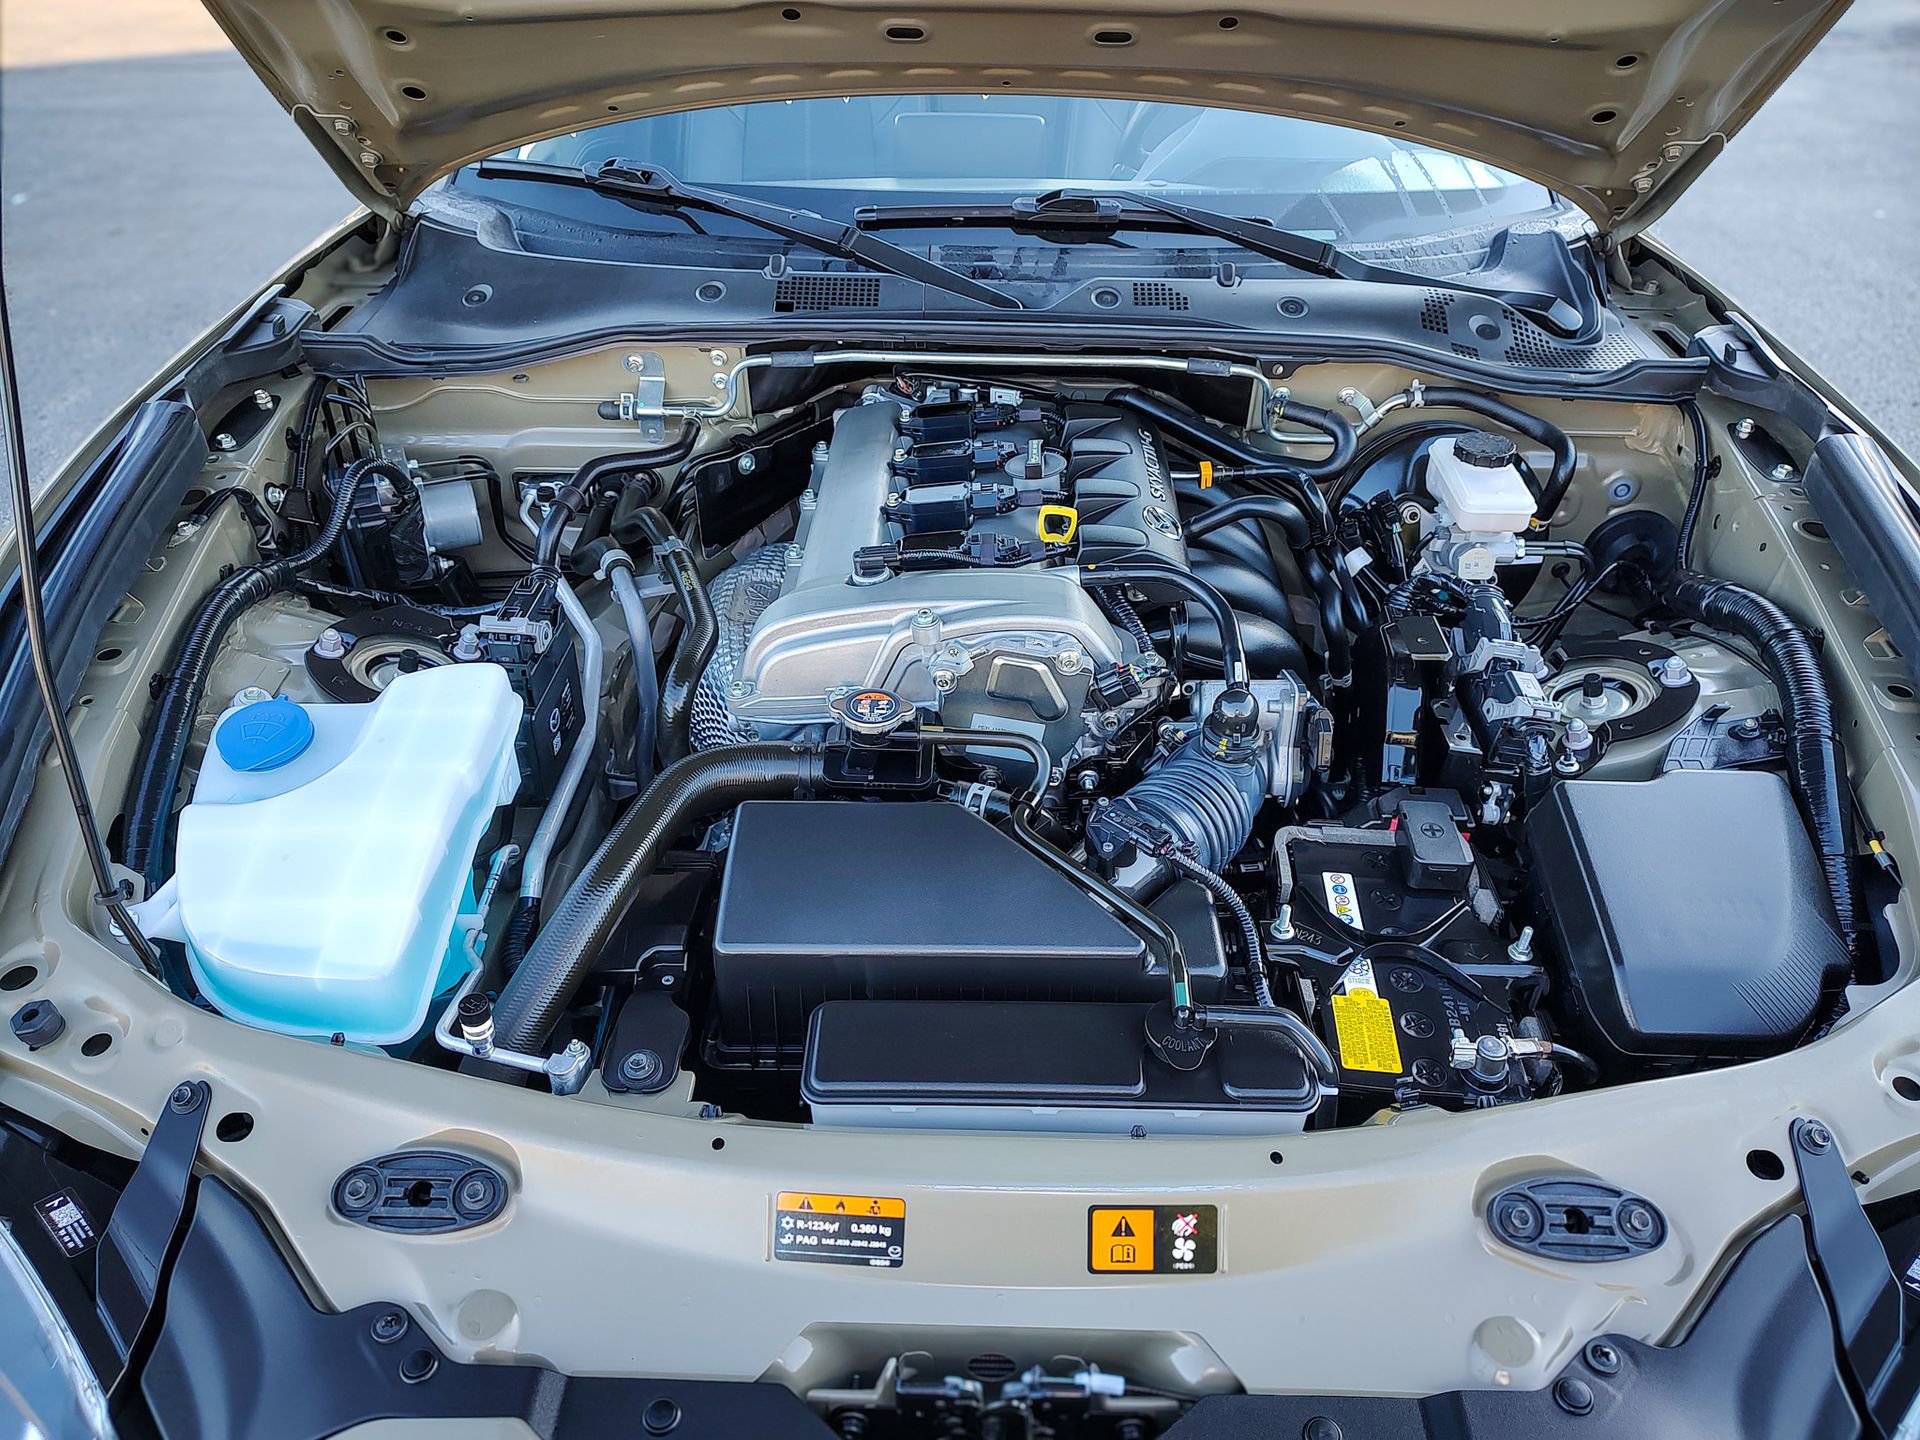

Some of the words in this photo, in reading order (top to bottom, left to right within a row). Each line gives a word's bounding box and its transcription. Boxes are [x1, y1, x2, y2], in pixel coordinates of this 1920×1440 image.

[1137, 427, 1167, 502] SKYACTIV-G
[1294, 927, 1323, 946] N243
[1161, 1035, 1205, 1052] COOLANT
[796, 1219, 840, 1233] R-1234yf
[879, 1224, 892, 1237] kg
[795, 1234, 818, 1245] PAG
